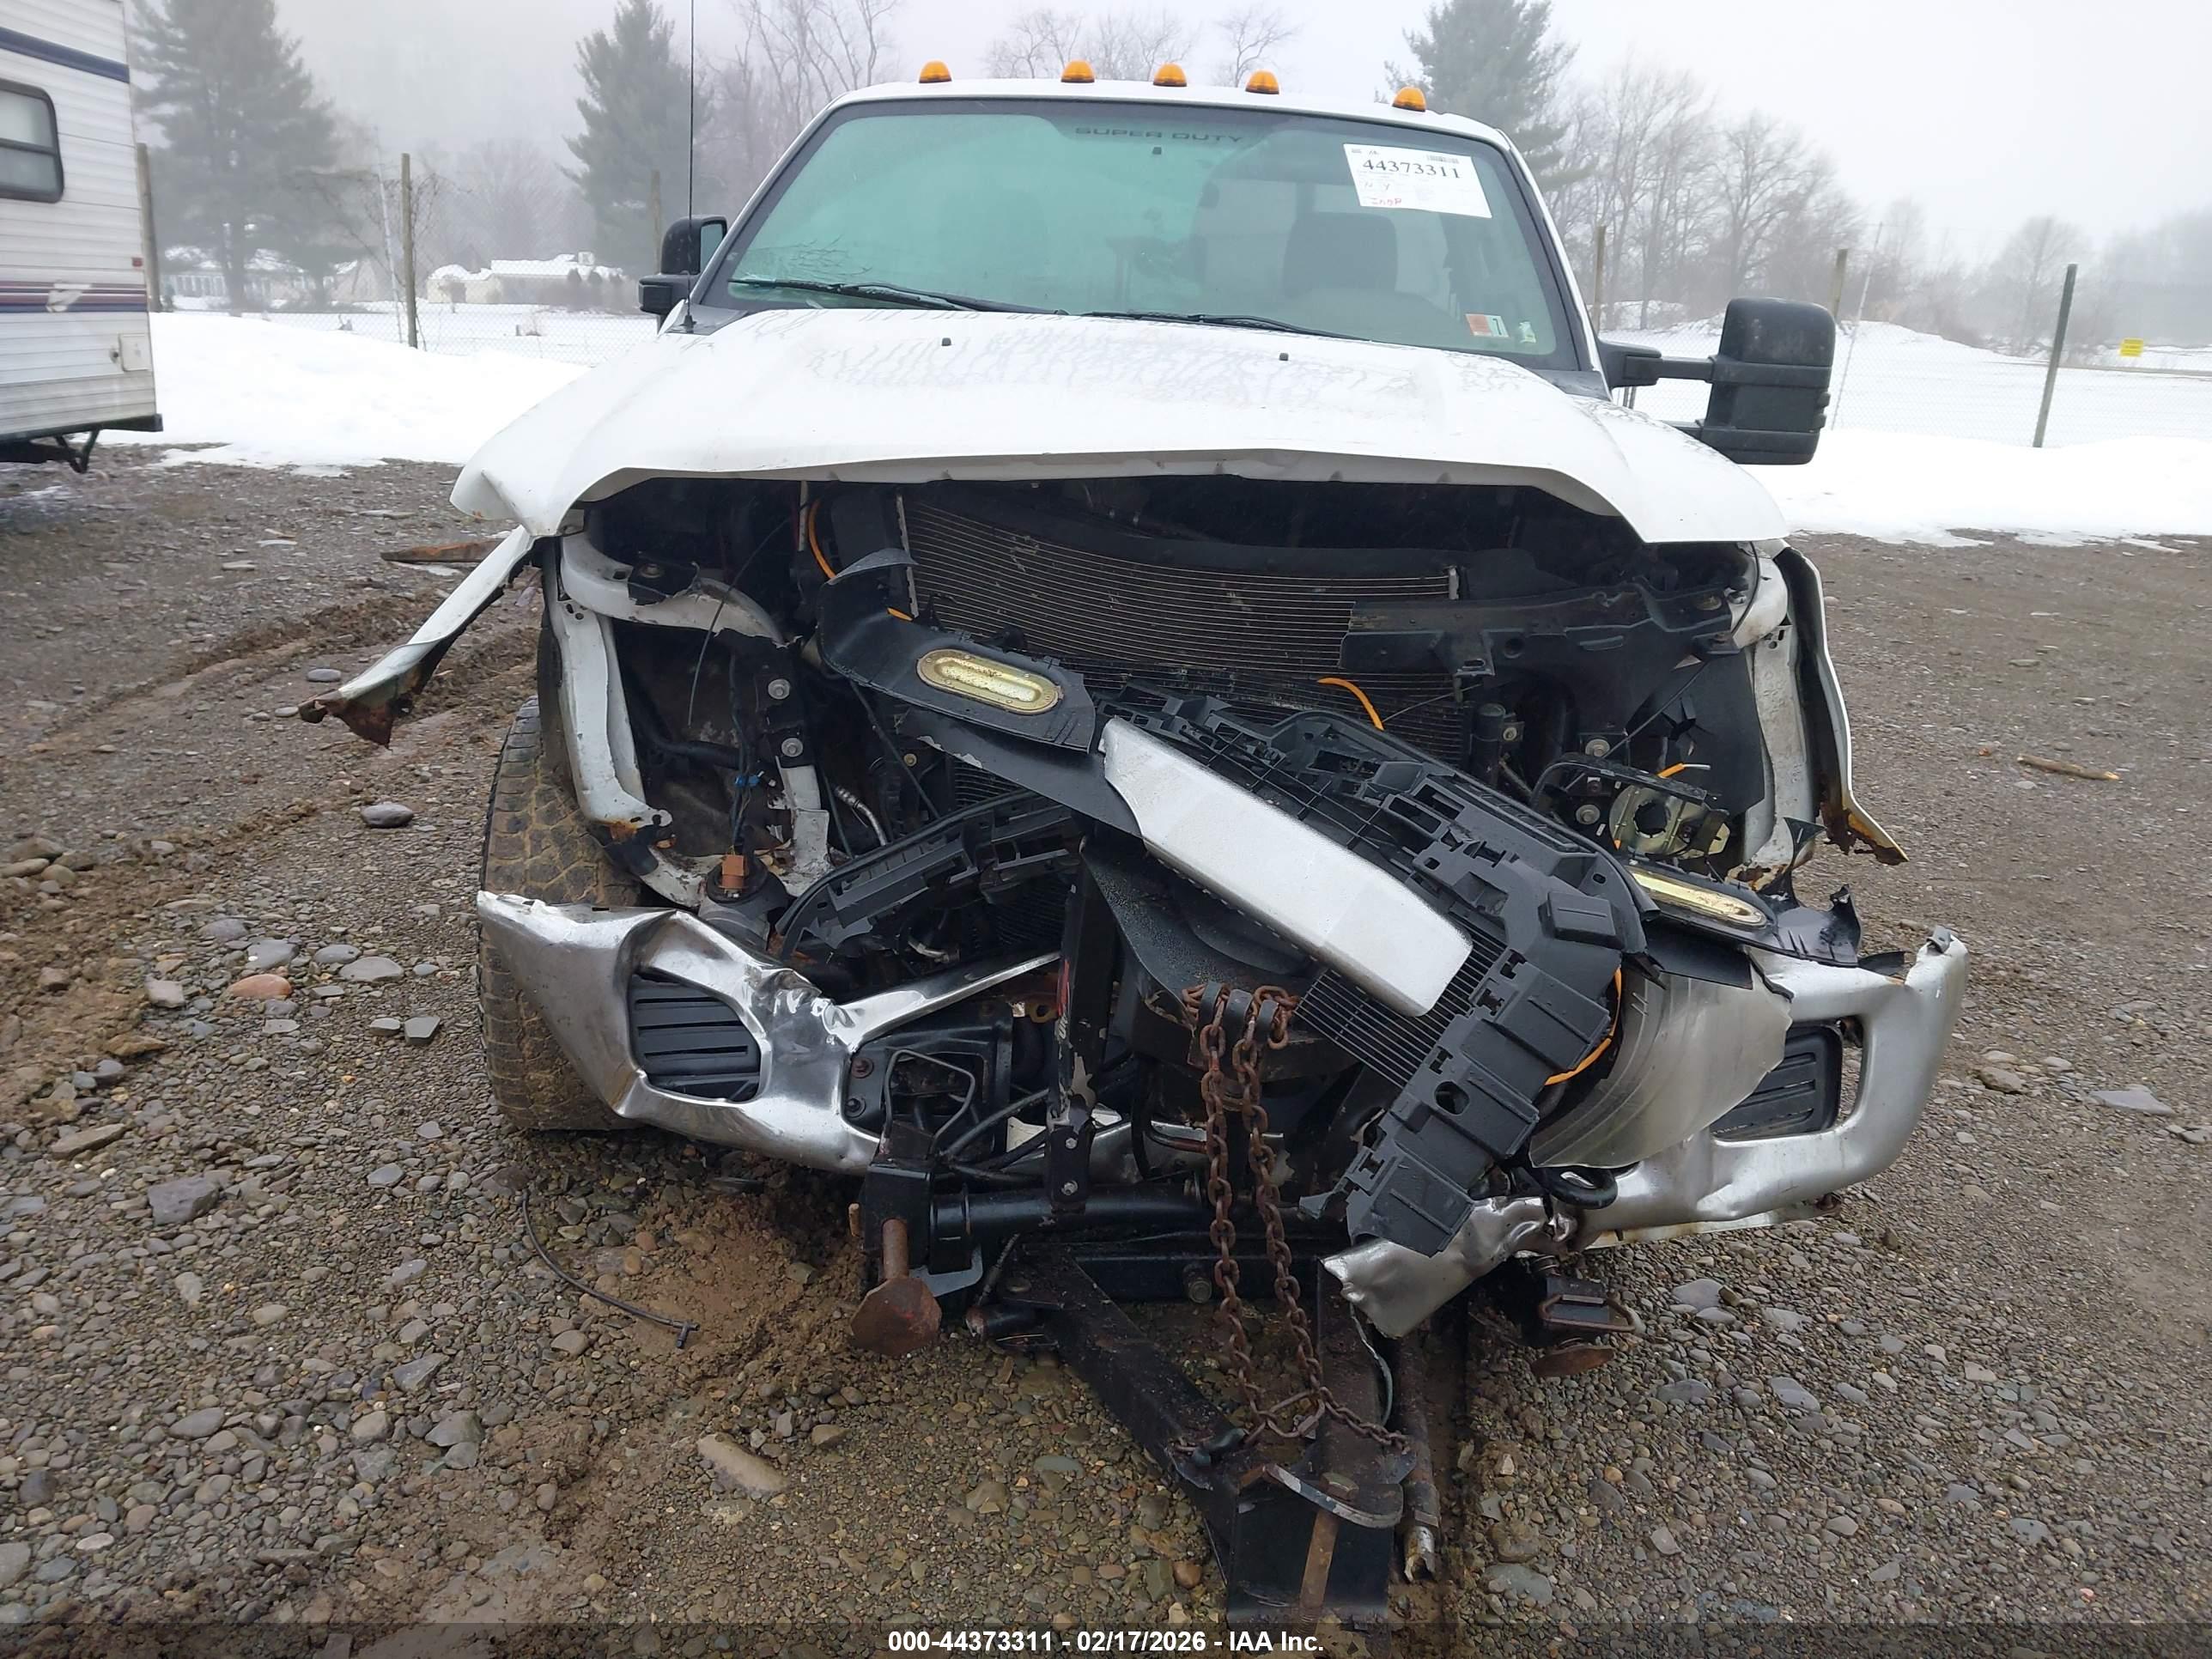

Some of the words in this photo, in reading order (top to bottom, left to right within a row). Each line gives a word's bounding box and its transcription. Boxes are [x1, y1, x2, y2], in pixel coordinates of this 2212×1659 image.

[1075, 127, 1163, 138] SUPER
[1172, 132, 1244, 143] DUTY
[1362, 158, 1461, 179] 44373311
